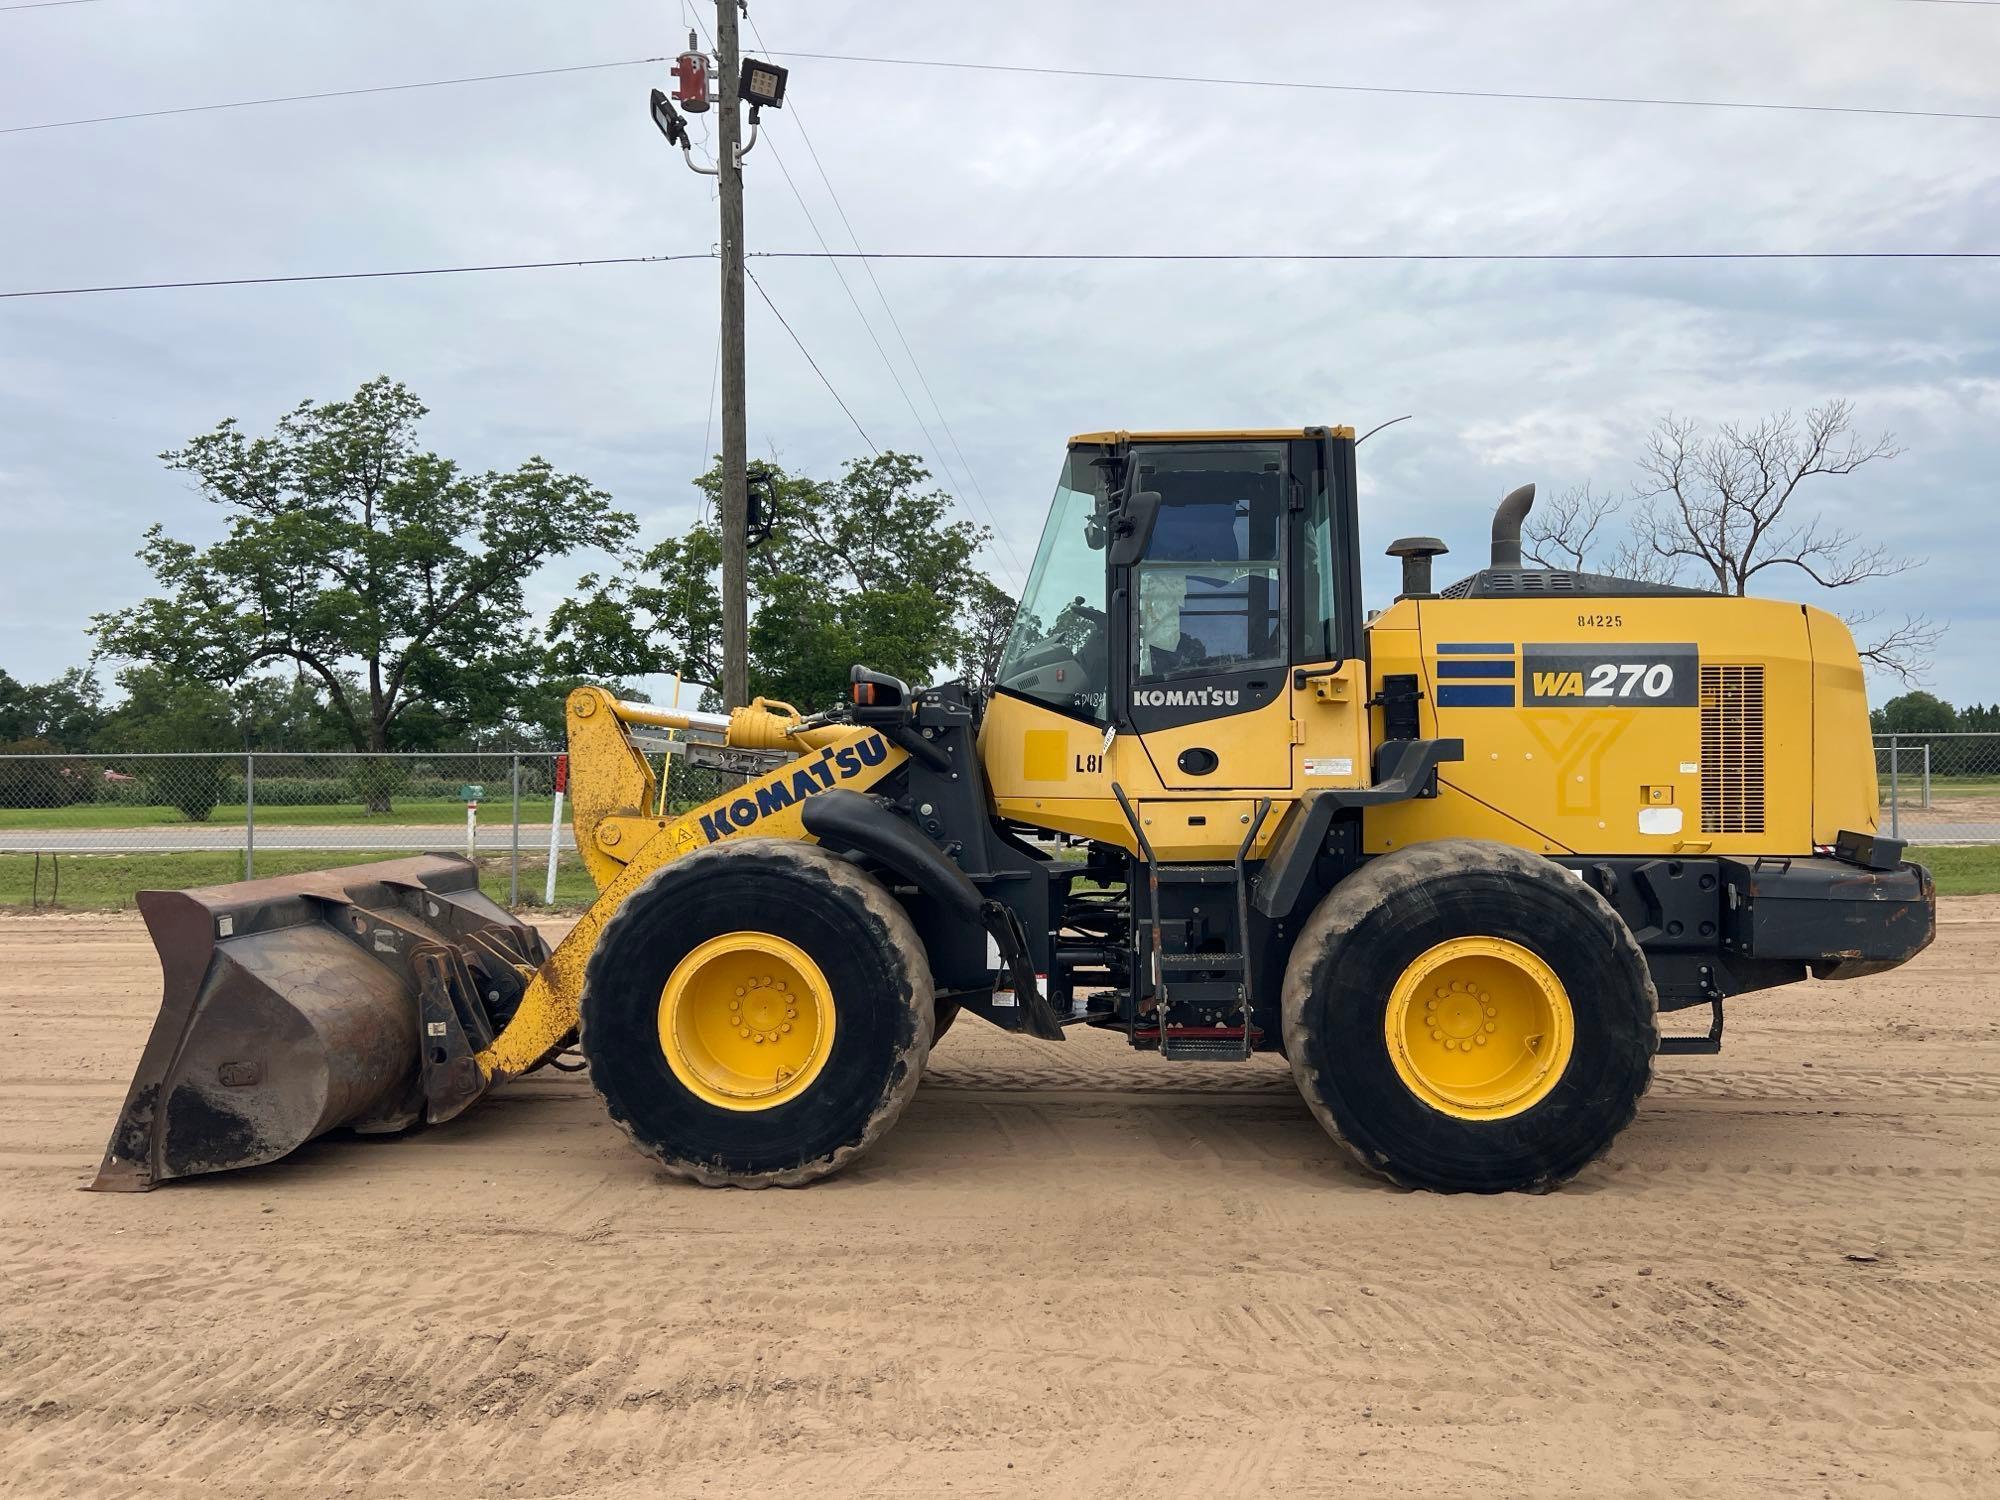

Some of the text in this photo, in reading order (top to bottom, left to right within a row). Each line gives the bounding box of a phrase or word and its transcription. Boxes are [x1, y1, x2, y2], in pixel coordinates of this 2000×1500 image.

[1577, 615, 1623, 627] 84225
[1532, 663, 1674, 698] WA270
[1133, 686, 1239, 706] KOMATSU
[699, 733, 888, 844] KOMATSU
